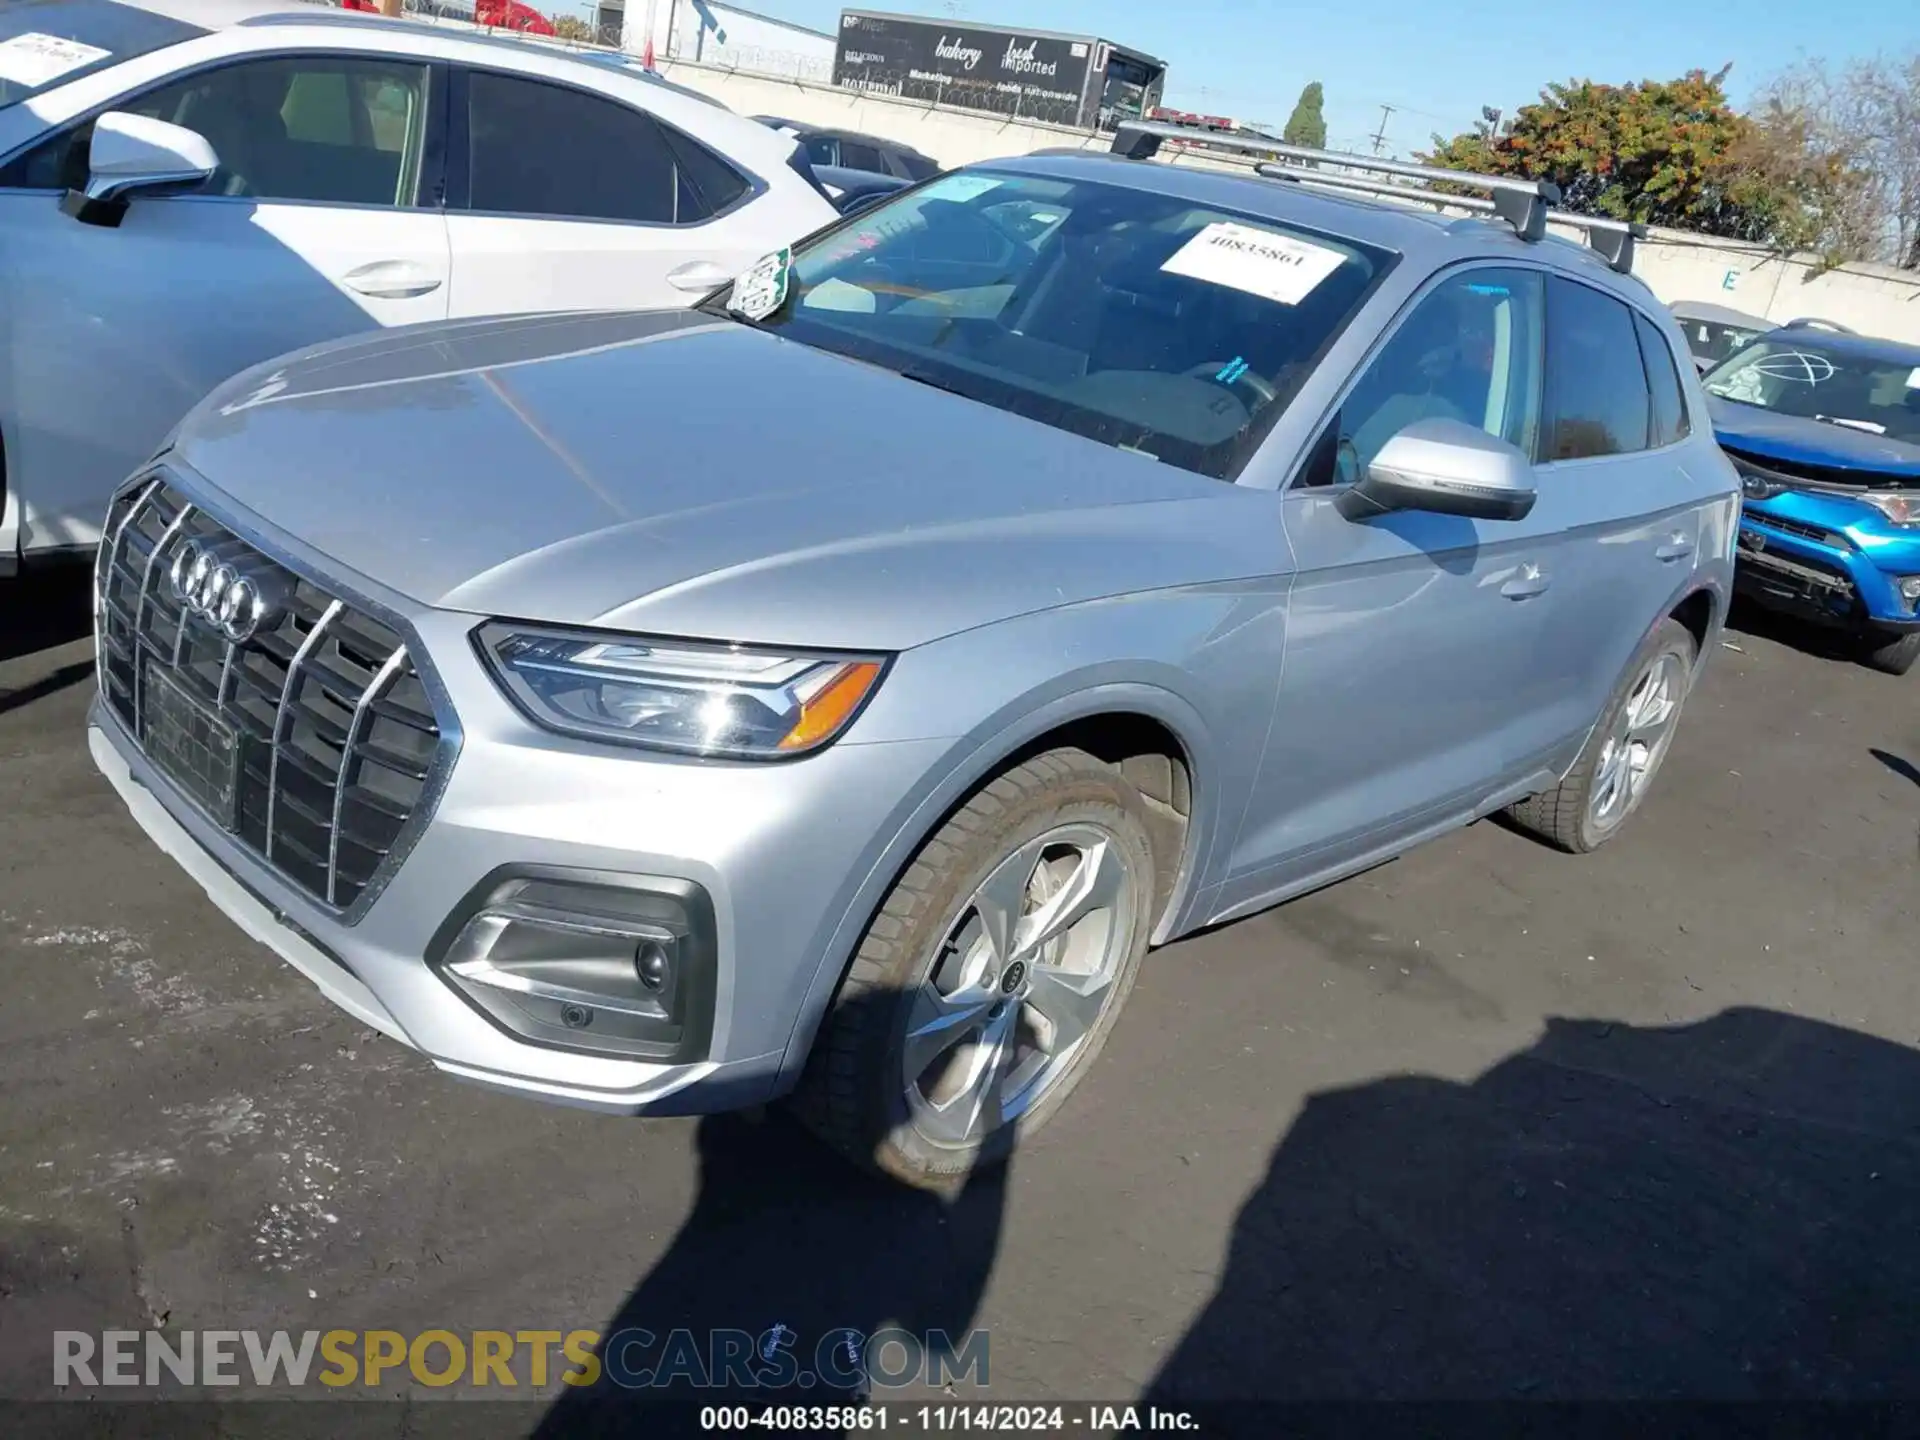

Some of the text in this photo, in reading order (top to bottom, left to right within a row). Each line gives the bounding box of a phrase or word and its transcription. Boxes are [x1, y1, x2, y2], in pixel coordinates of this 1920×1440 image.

[935, 35, 983, 70] bakery
[1001, 53, 1058, 76] imported
[1023, 87, 1079, 102] nationwide
[1722, 269, 1741, 291] E
